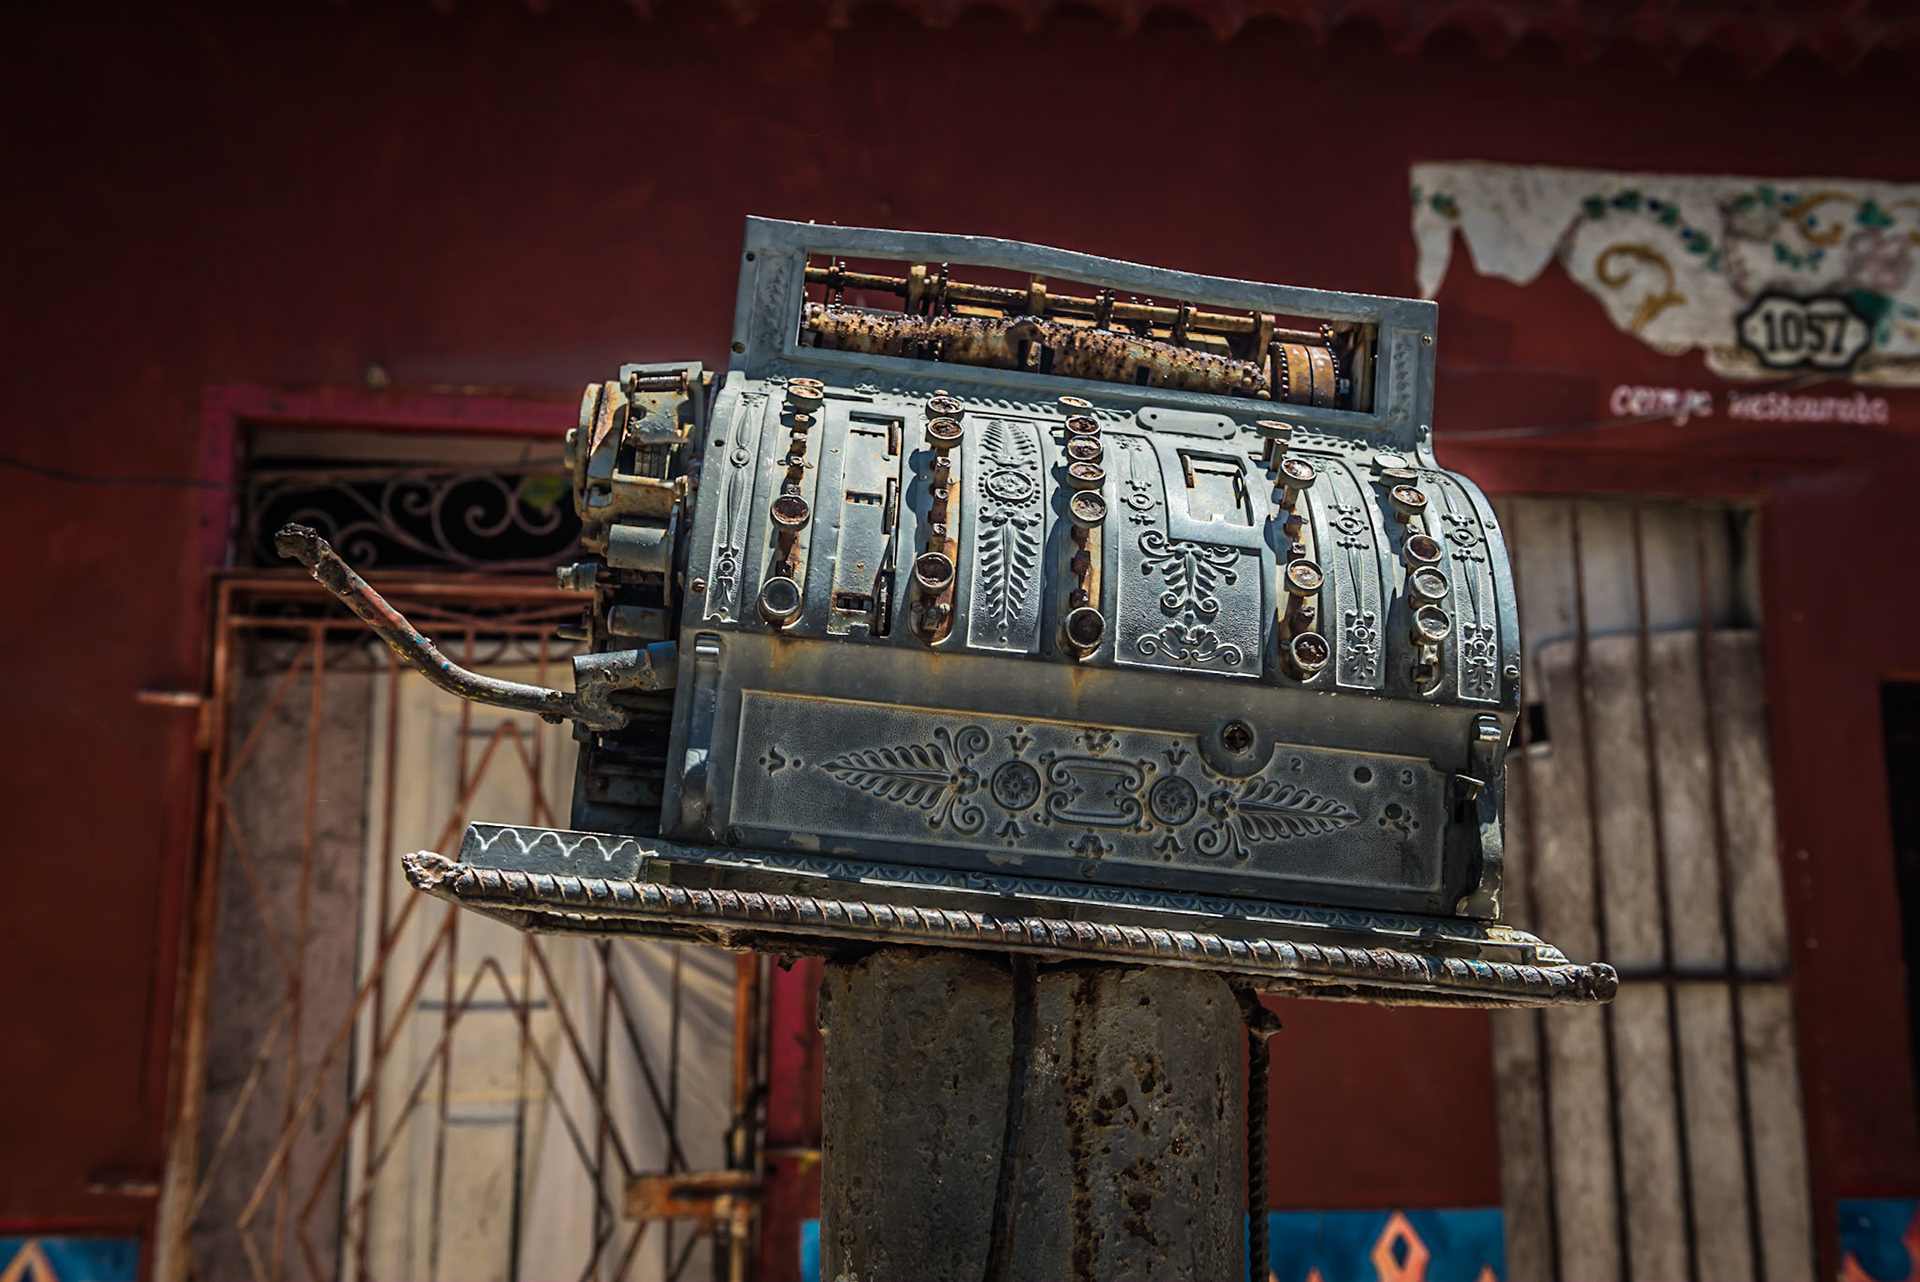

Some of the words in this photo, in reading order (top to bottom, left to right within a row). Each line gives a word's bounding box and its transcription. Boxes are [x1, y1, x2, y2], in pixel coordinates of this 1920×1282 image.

[1762, 309, 1848, 355] 1057
[1290, 757, 1302, 772] 2
[1402, 769, 1414, 786] 3
